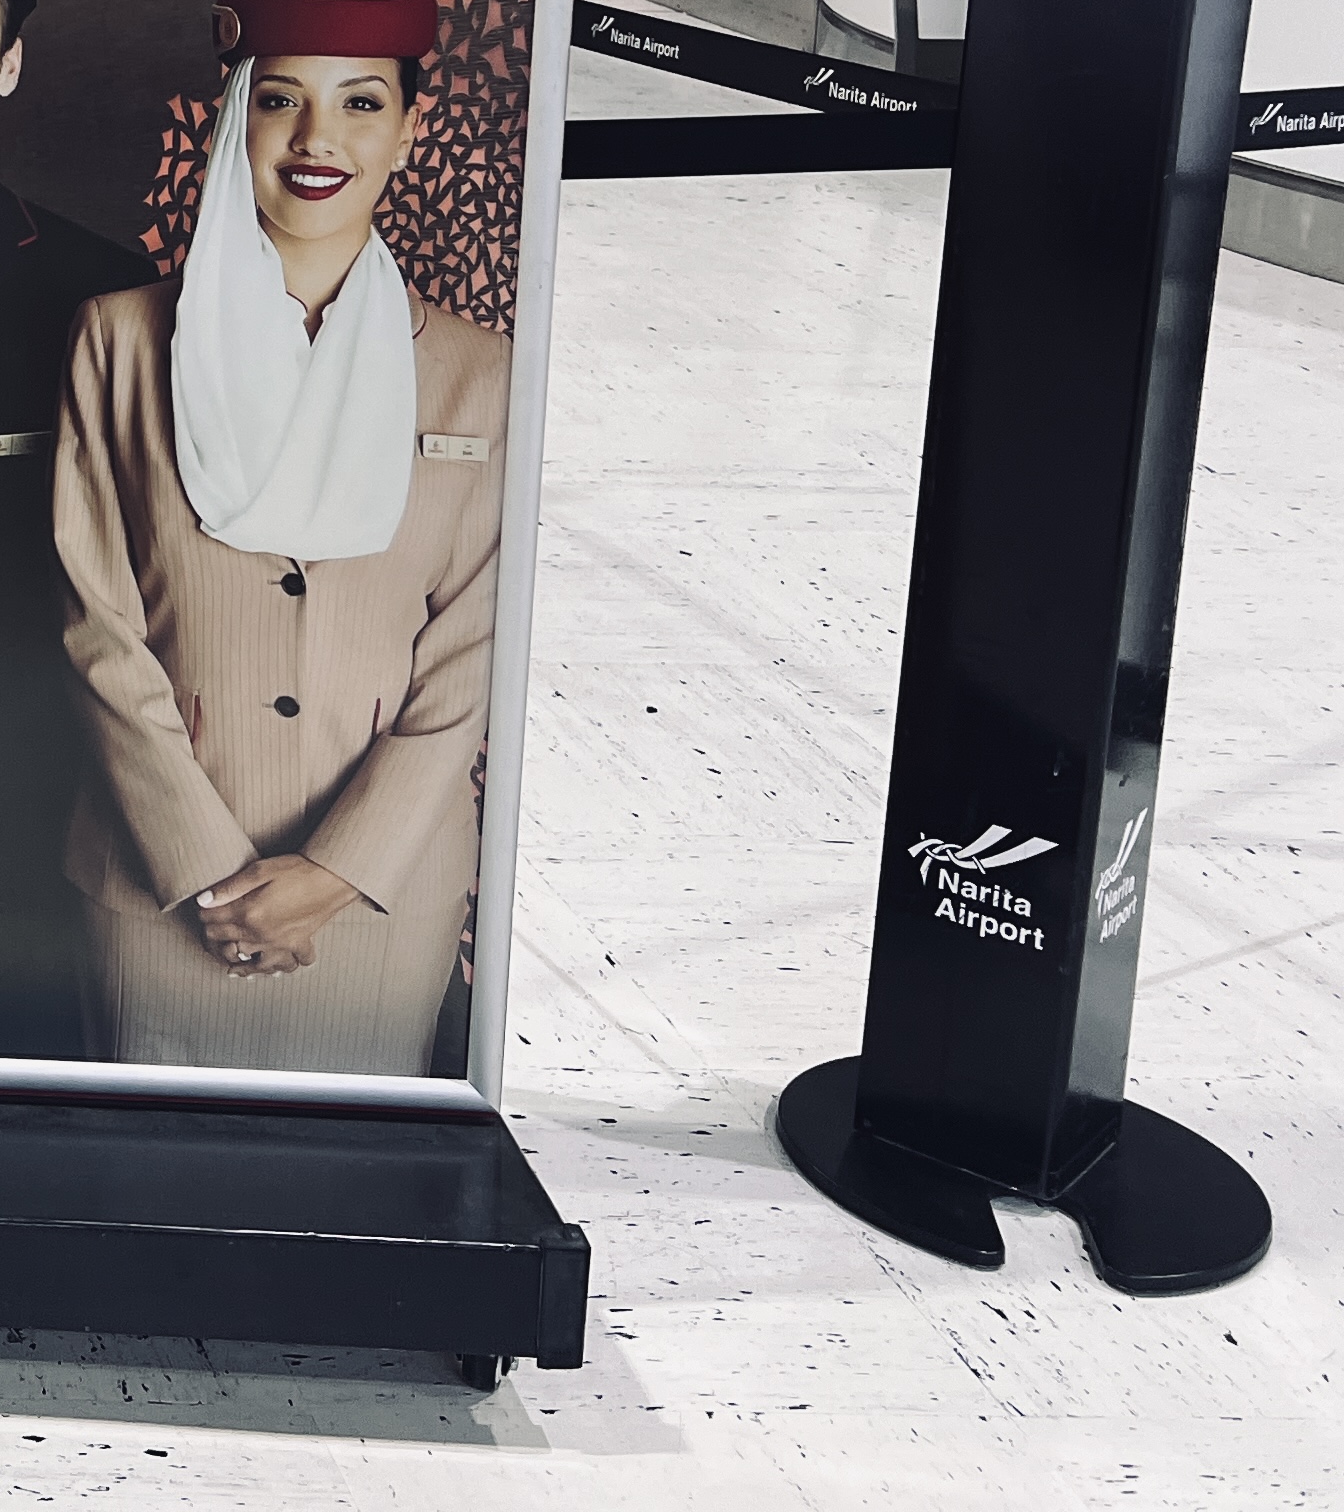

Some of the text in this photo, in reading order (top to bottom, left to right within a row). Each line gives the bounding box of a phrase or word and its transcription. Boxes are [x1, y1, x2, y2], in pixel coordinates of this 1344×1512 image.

[610, 28, 680, 60] Narita Airport
[828, 81, 867, 105] Narita
[1276, 113, 1316, 133] Narita
[938, 868, 1032, 918] Narita
[934, 897, 1045, 951] Airport
